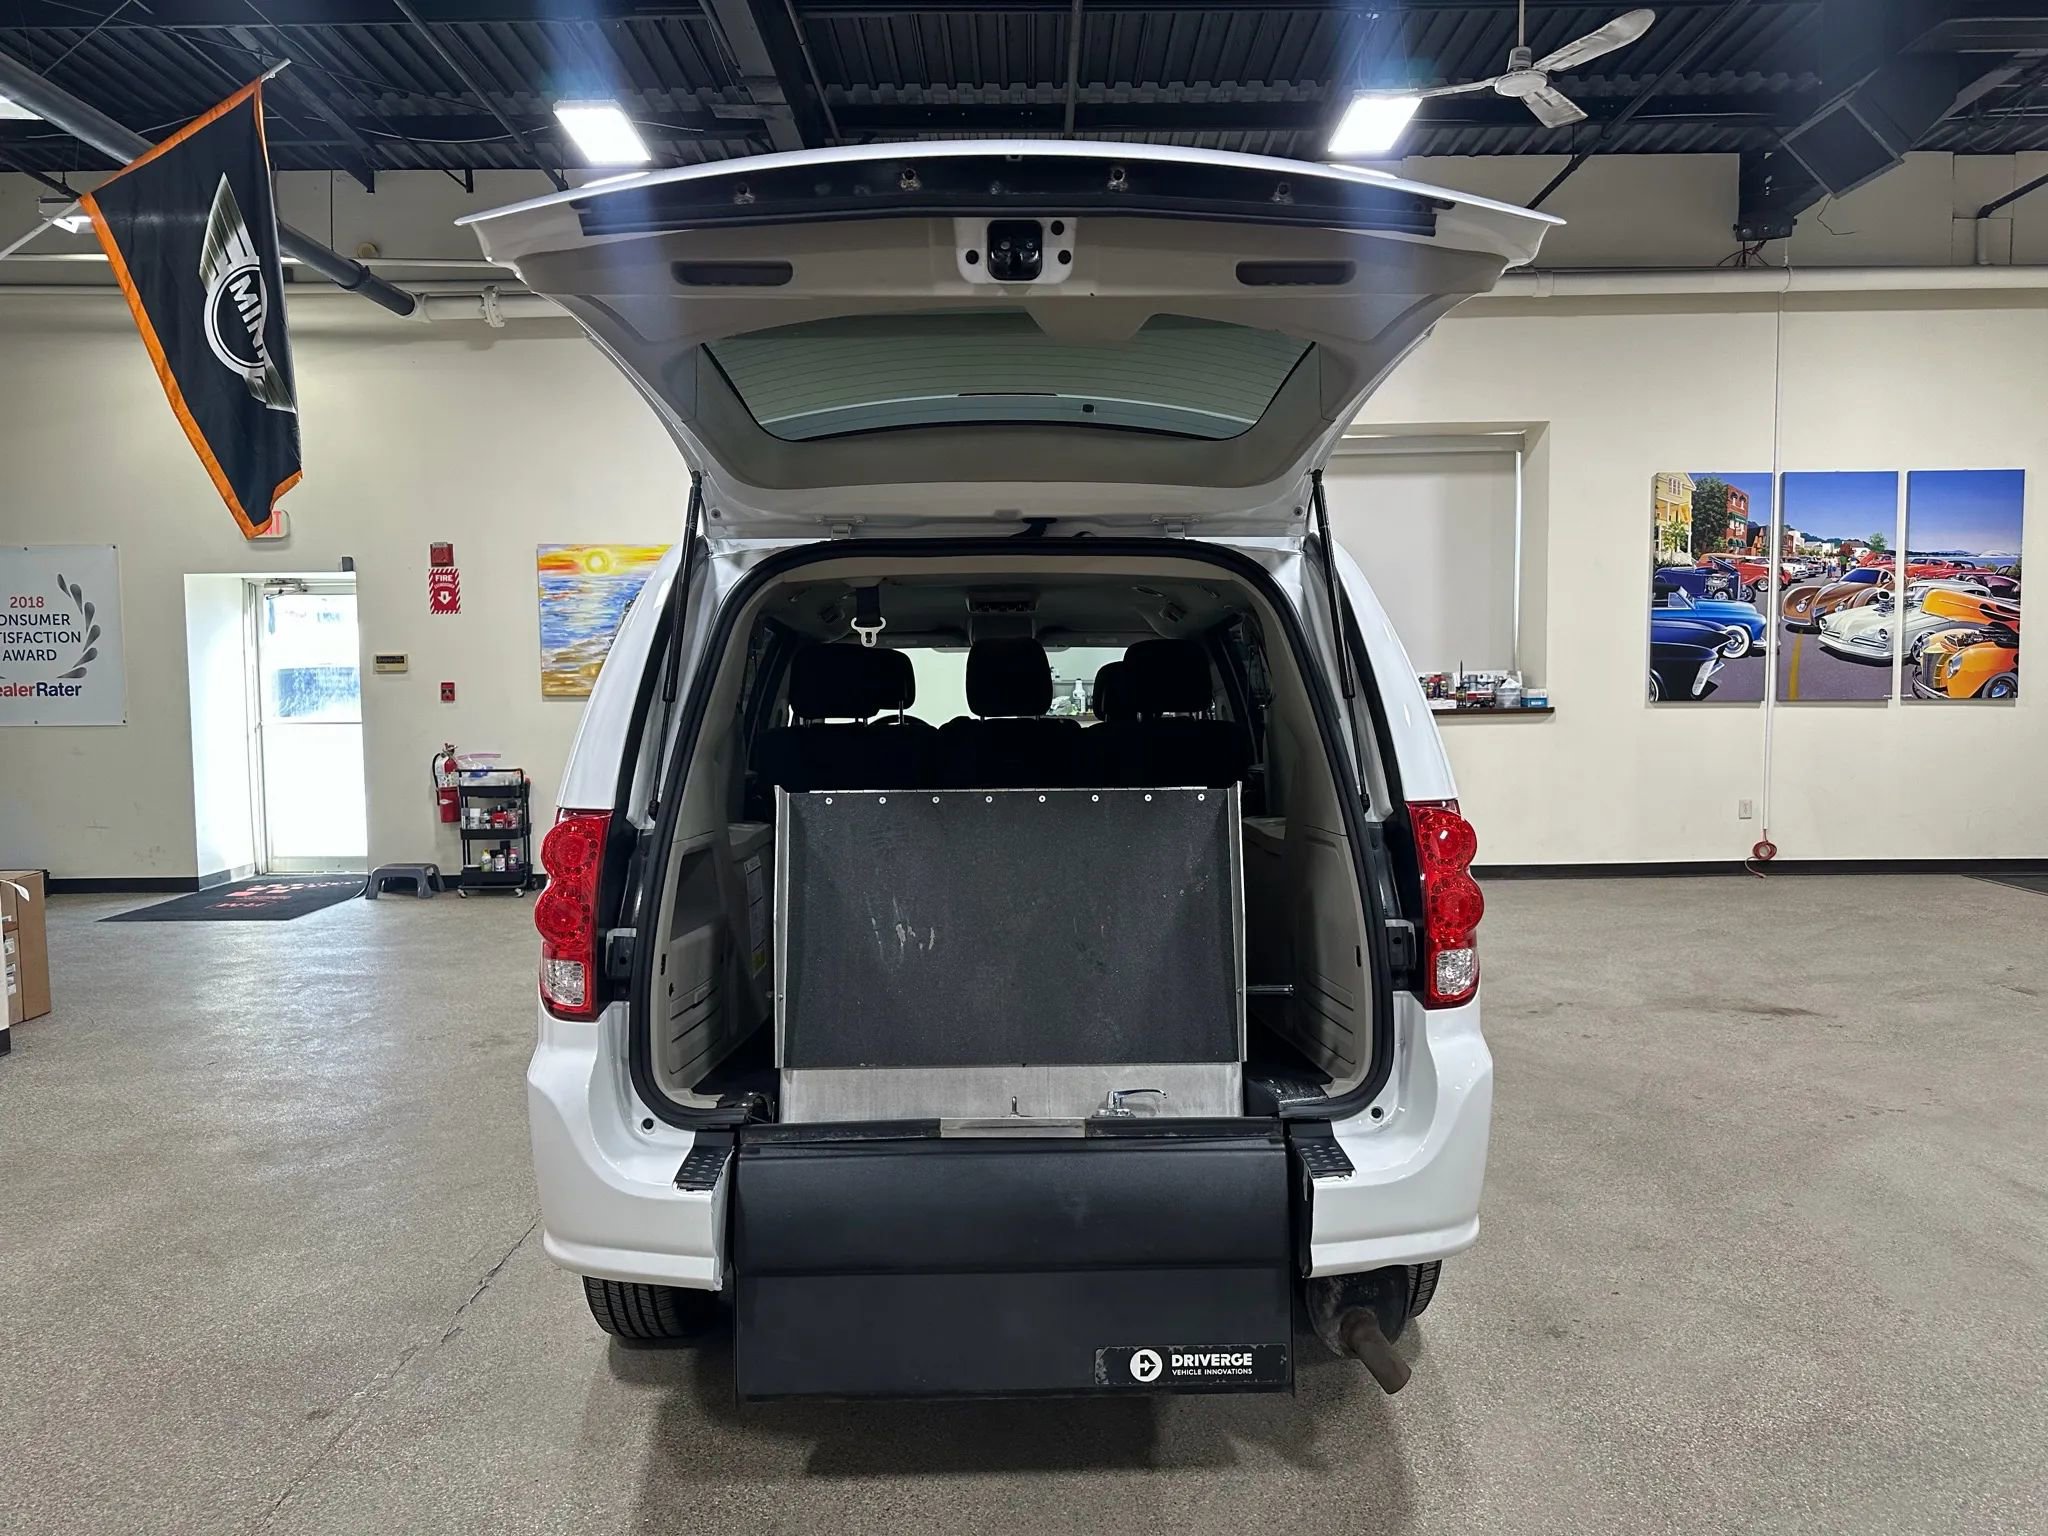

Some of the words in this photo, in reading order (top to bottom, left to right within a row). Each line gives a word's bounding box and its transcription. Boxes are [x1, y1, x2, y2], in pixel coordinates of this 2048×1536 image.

[228, 274, 264, 359] MIN
[435, 574, 454, 582] FIRE
[9, 596, 45, 609] 2018
[2, 649, 57, 662] AWARD
[1171, 1353, 1253, 1367] DRIVERGE
